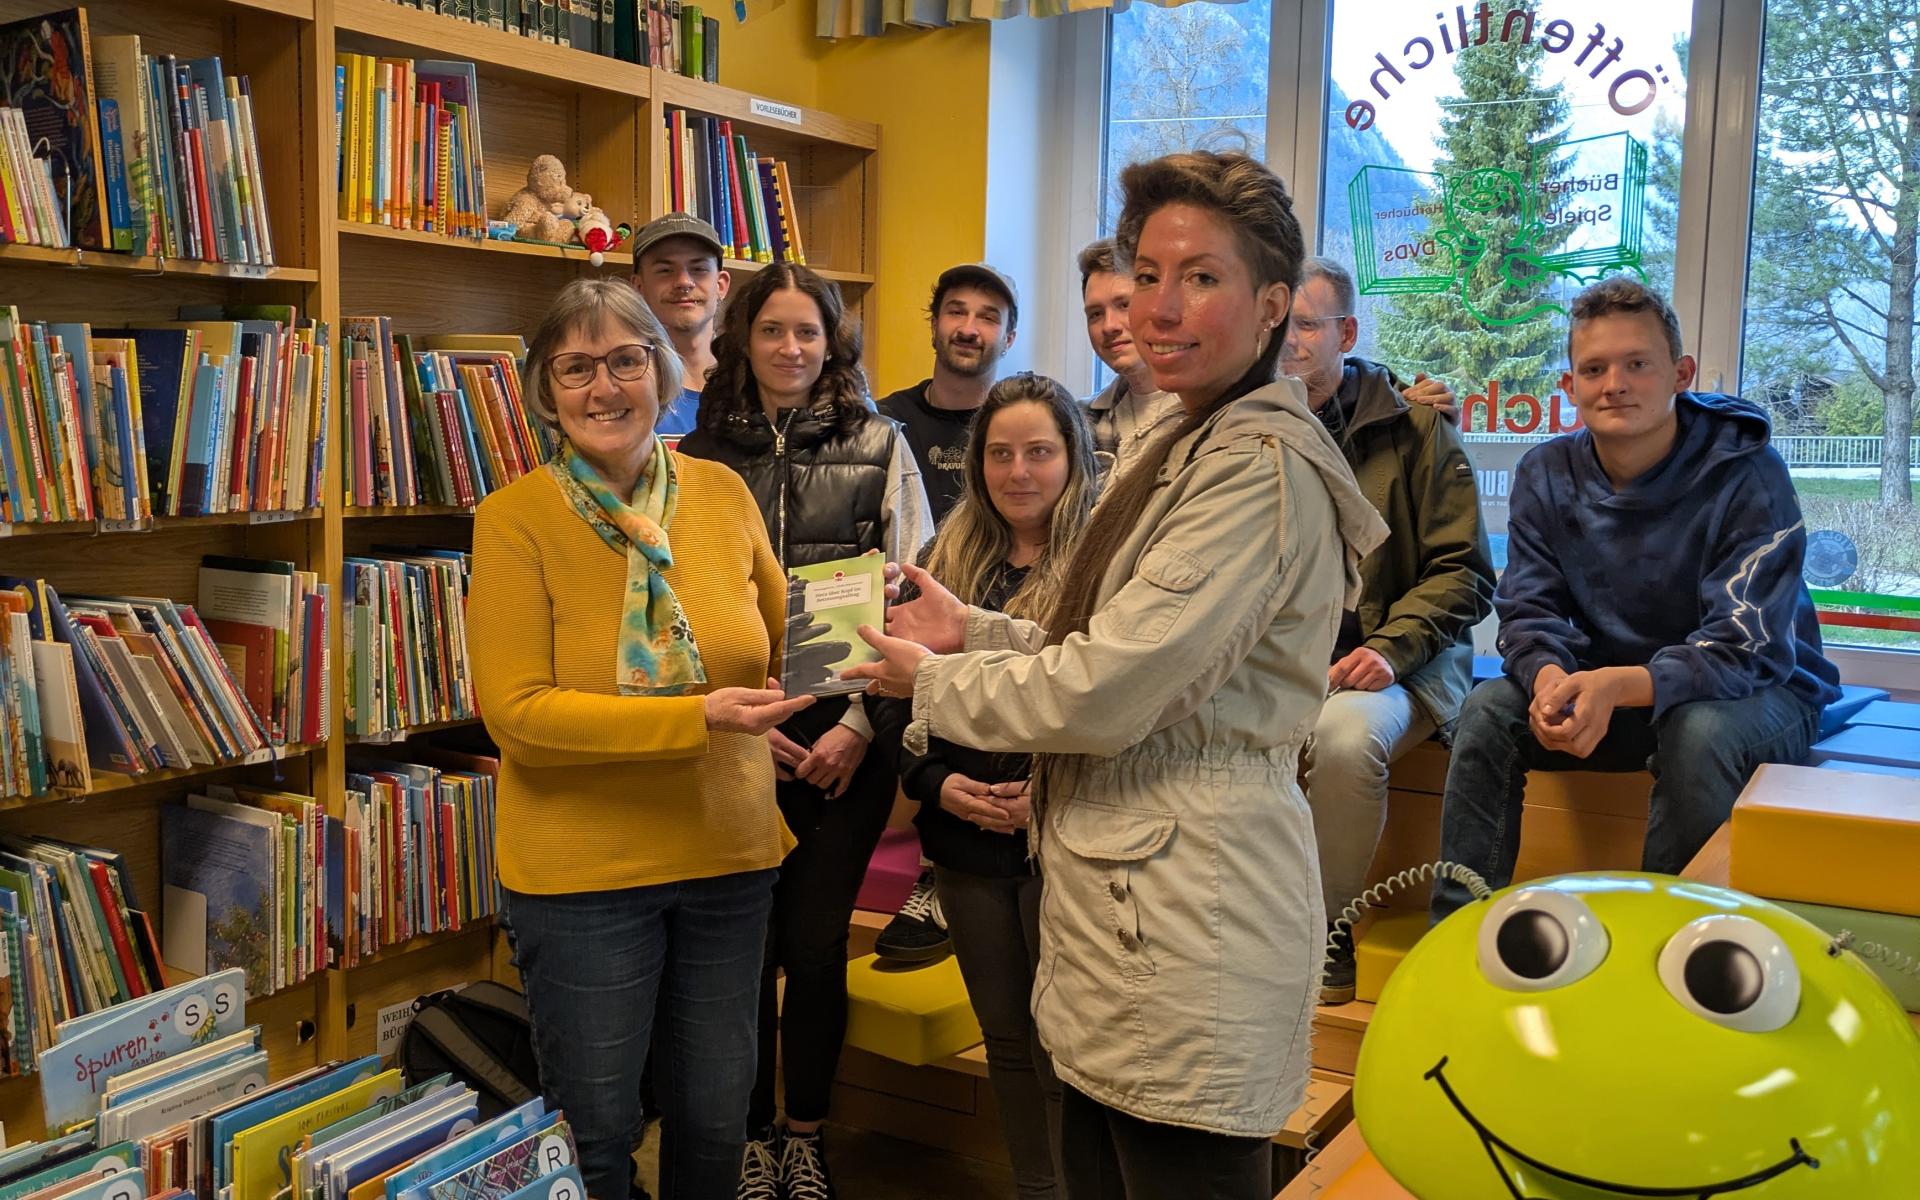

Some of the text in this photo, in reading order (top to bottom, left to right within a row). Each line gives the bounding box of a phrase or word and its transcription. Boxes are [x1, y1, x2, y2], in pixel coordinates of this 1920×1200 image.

[755, 102, 797, 120] VORLESEBÜCHER
[184, 1003, 201, 1027] S
[215, 992, 230, 1015] S
[74, 1033, 148, 1093] Spuren
[546, 1145, 564, 1172] R
